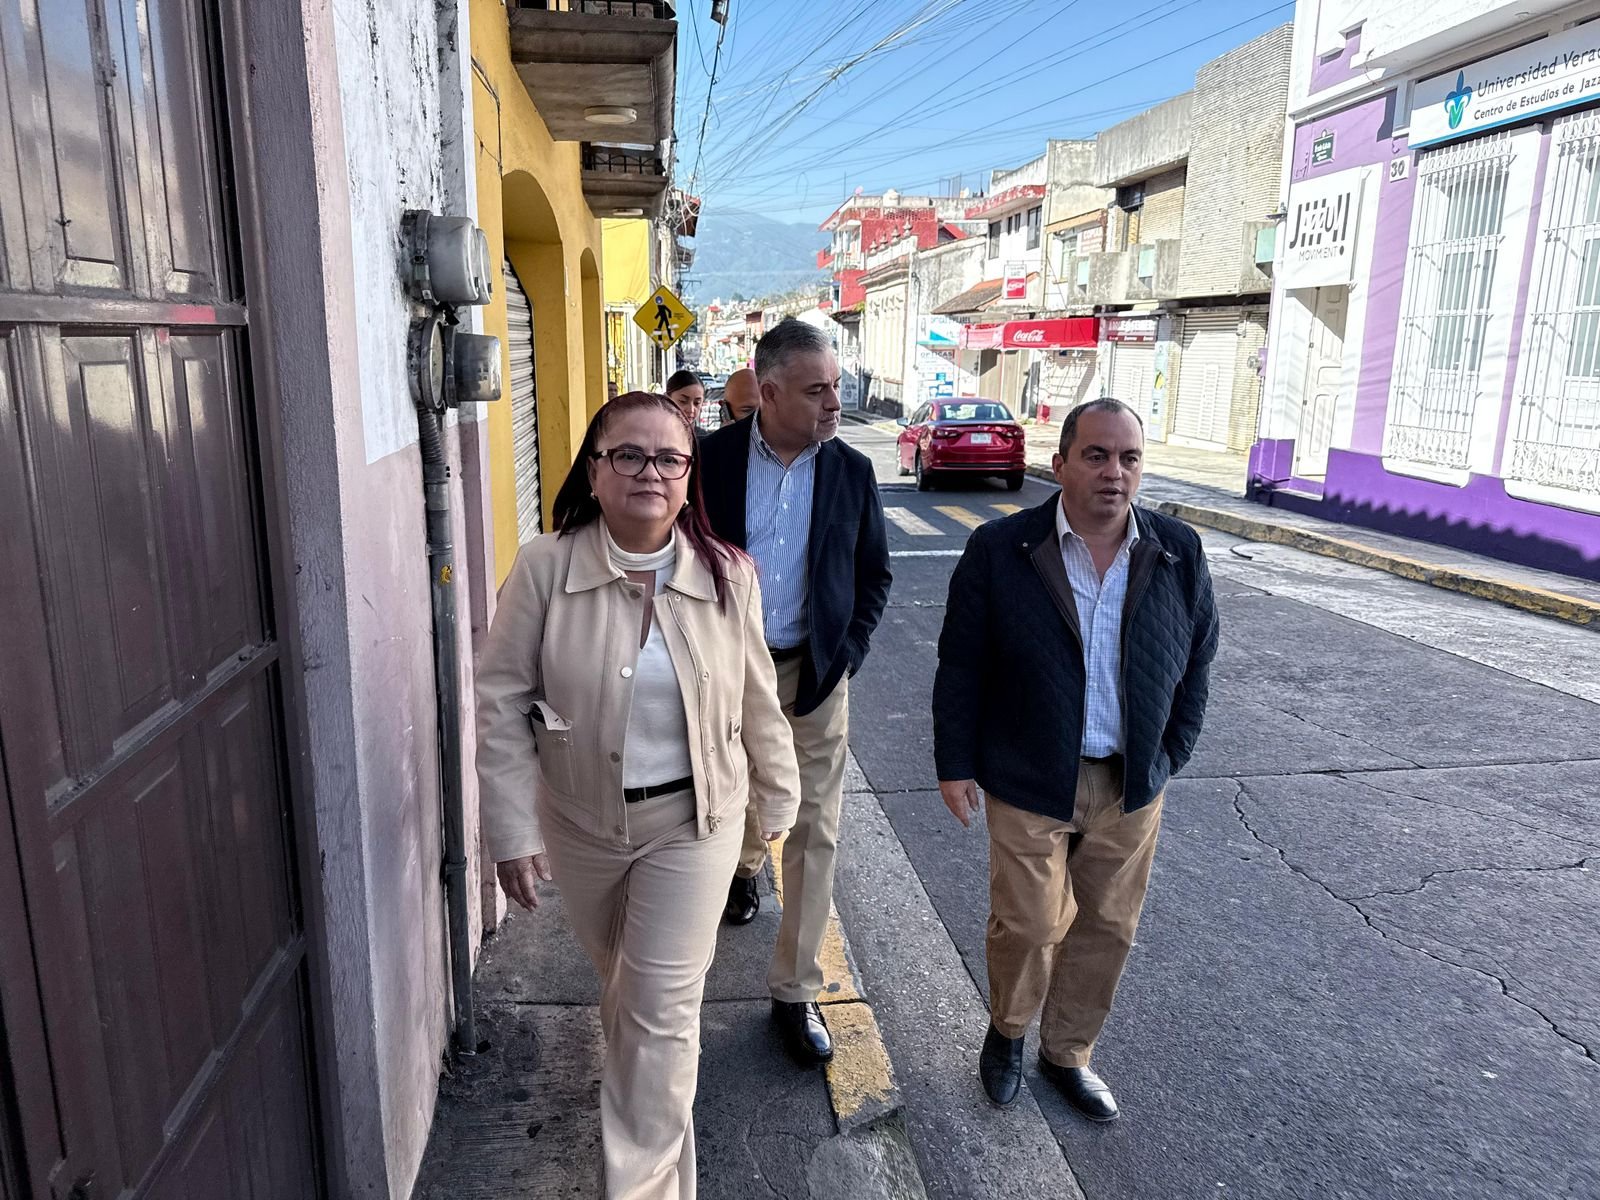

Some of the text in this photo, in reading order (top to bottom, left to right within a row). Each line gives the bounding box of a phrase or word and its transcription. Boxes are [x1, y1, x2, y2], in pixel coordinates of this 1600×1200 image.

[1477, 55, 1559, 98] Universidad
[1474, 106, 1504, 121] Centro
[1506, 100, 1517, 111] de
[1519, 88, 1560, 108] Estudios
[1562, 82, 1575, 96] de
[1390, 159, 1405, 178] 30
